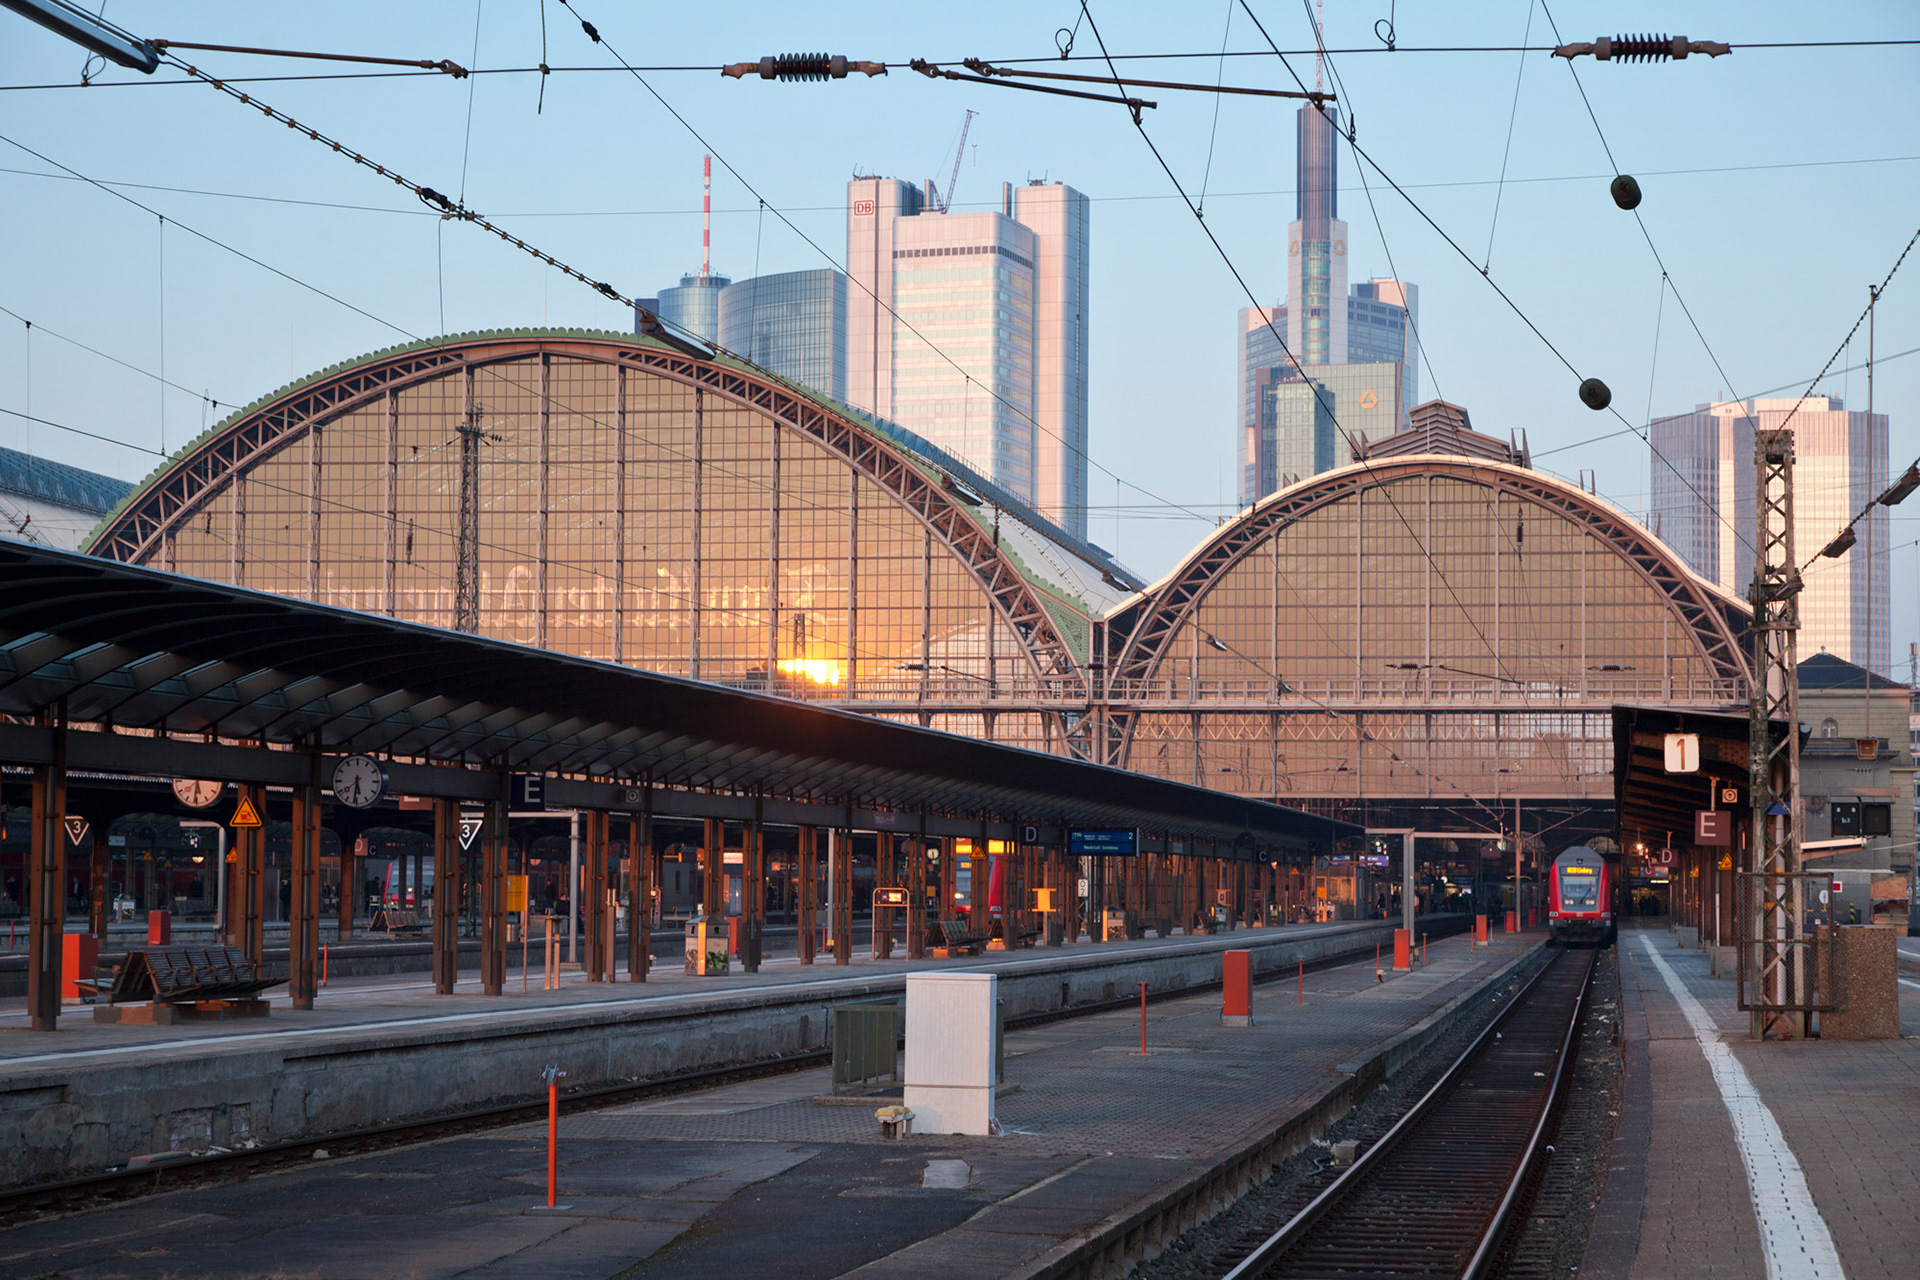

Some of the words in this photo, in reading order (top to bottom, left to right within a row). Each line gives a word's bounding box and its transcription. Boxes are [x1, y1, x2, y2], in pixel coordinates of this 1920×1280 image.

[857, 203, 871, 213] DB
[1677, 739, 1685, 770] 1
[525, 777, 540, 802] E
[73, 820, 81, 834] 3
[462, 824, 470, 838] 3
[1701, 812, 1716, 836] E
[1025, 826, 1037, 842] D
[1128, 832, 1134, 840] 2
[369, 845, 377, 855] C
[1259, 850, 1267, 862] C
[1662, 850, 1672, 863] D
